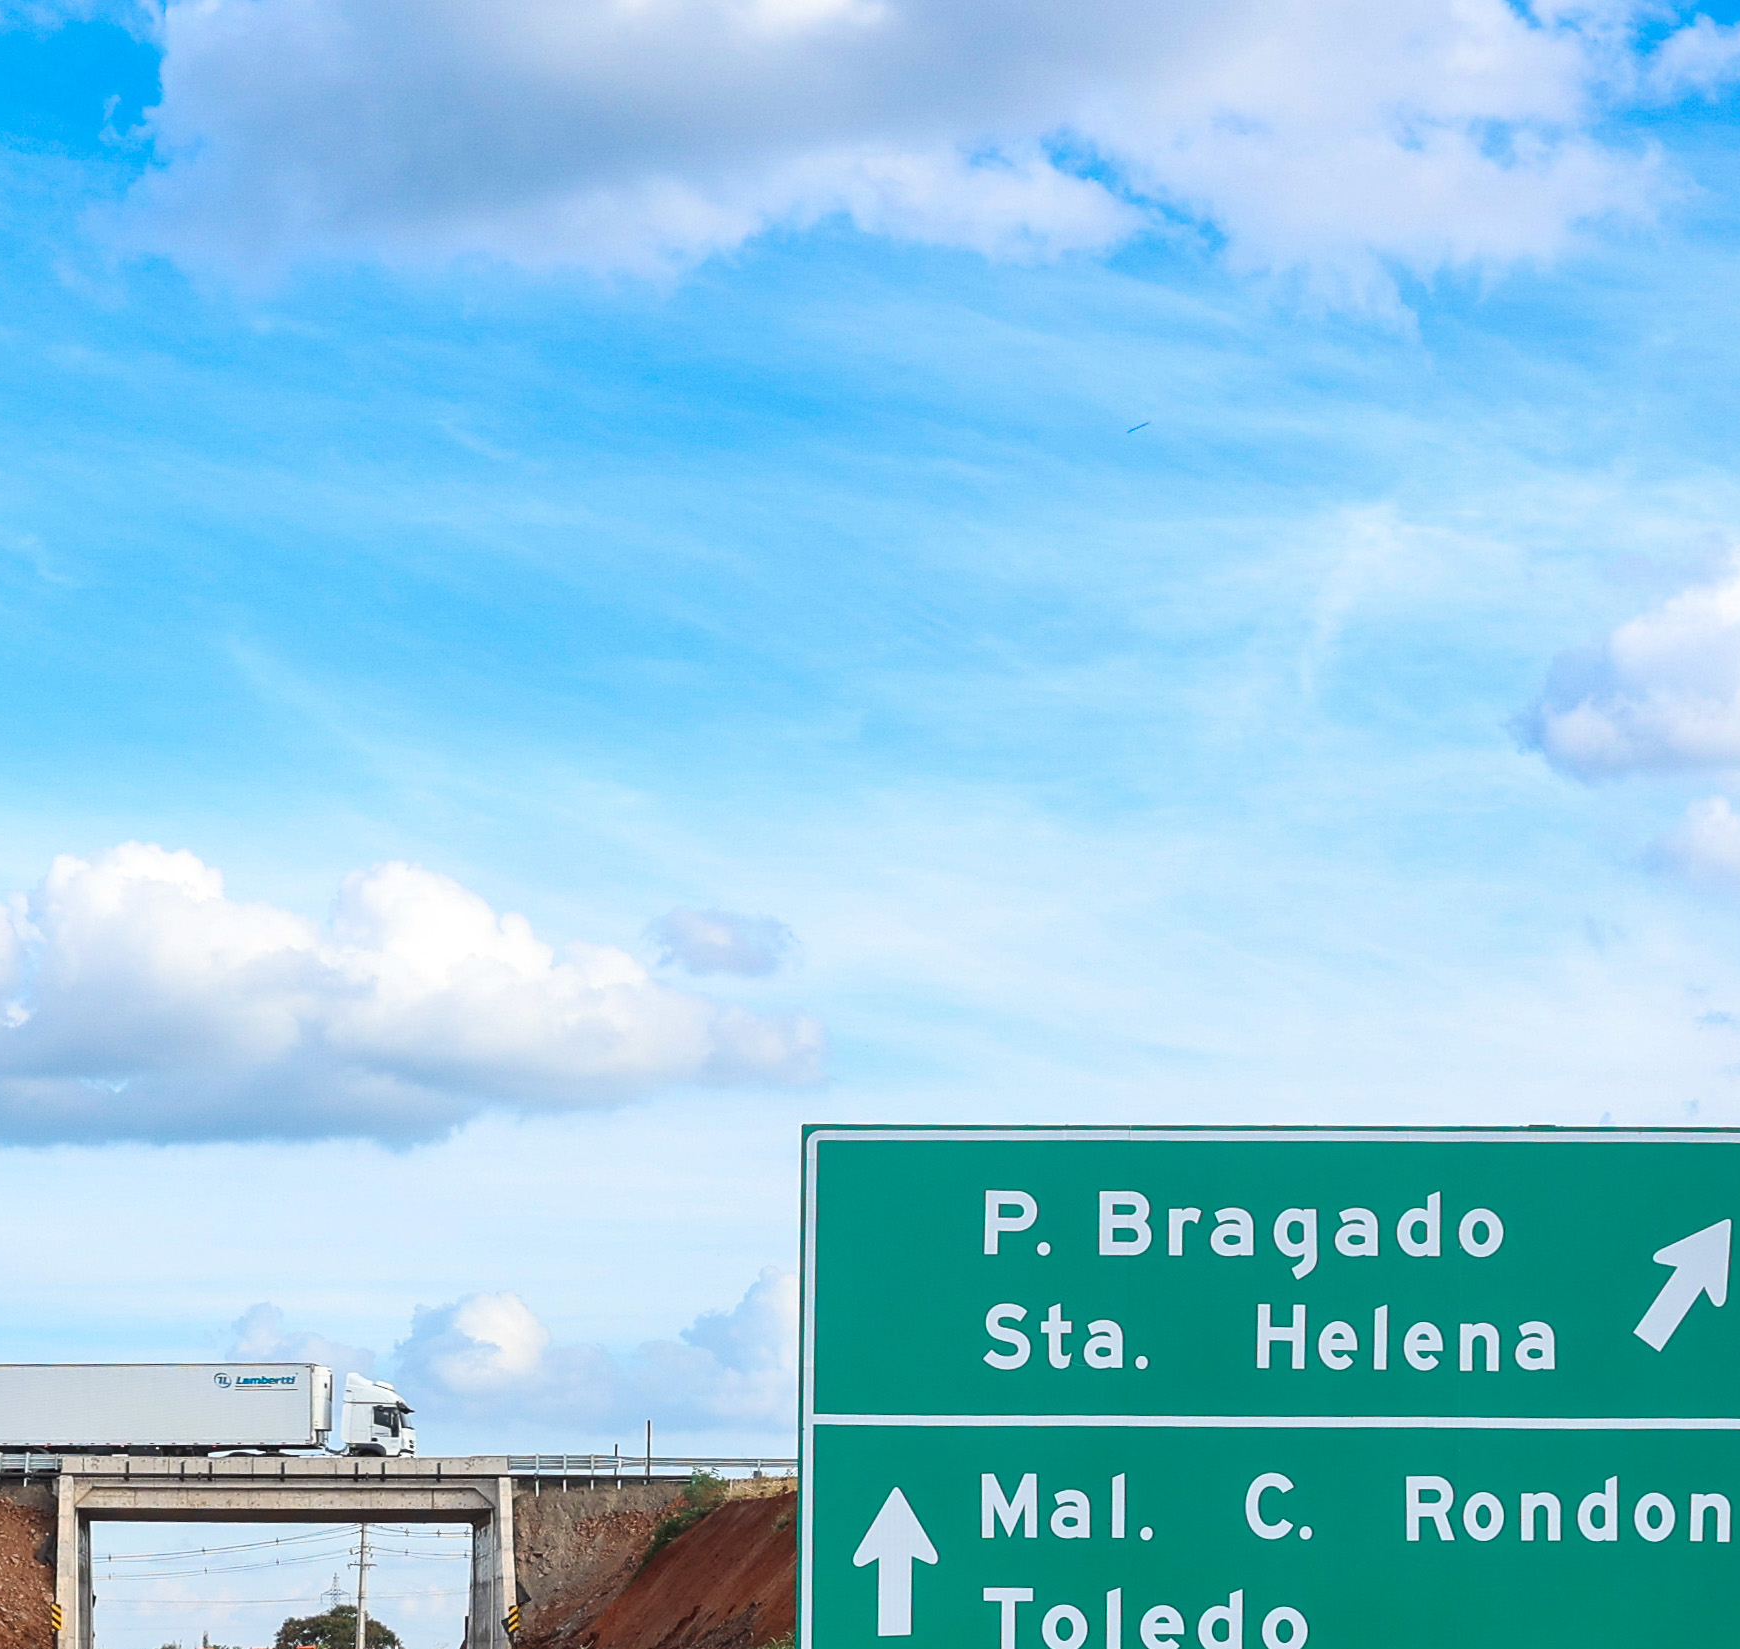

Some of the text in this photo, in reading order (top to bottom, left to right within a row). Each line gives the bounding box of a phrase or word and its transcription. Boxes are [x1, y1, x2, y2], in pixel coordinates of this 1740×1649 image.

[983, 1189, 1504, 1280] P. Bragado
[983, 1302, 1557, 1372] Sta. Helena
[981, 1472, 1732, 1543] Mal. C. Rondon
